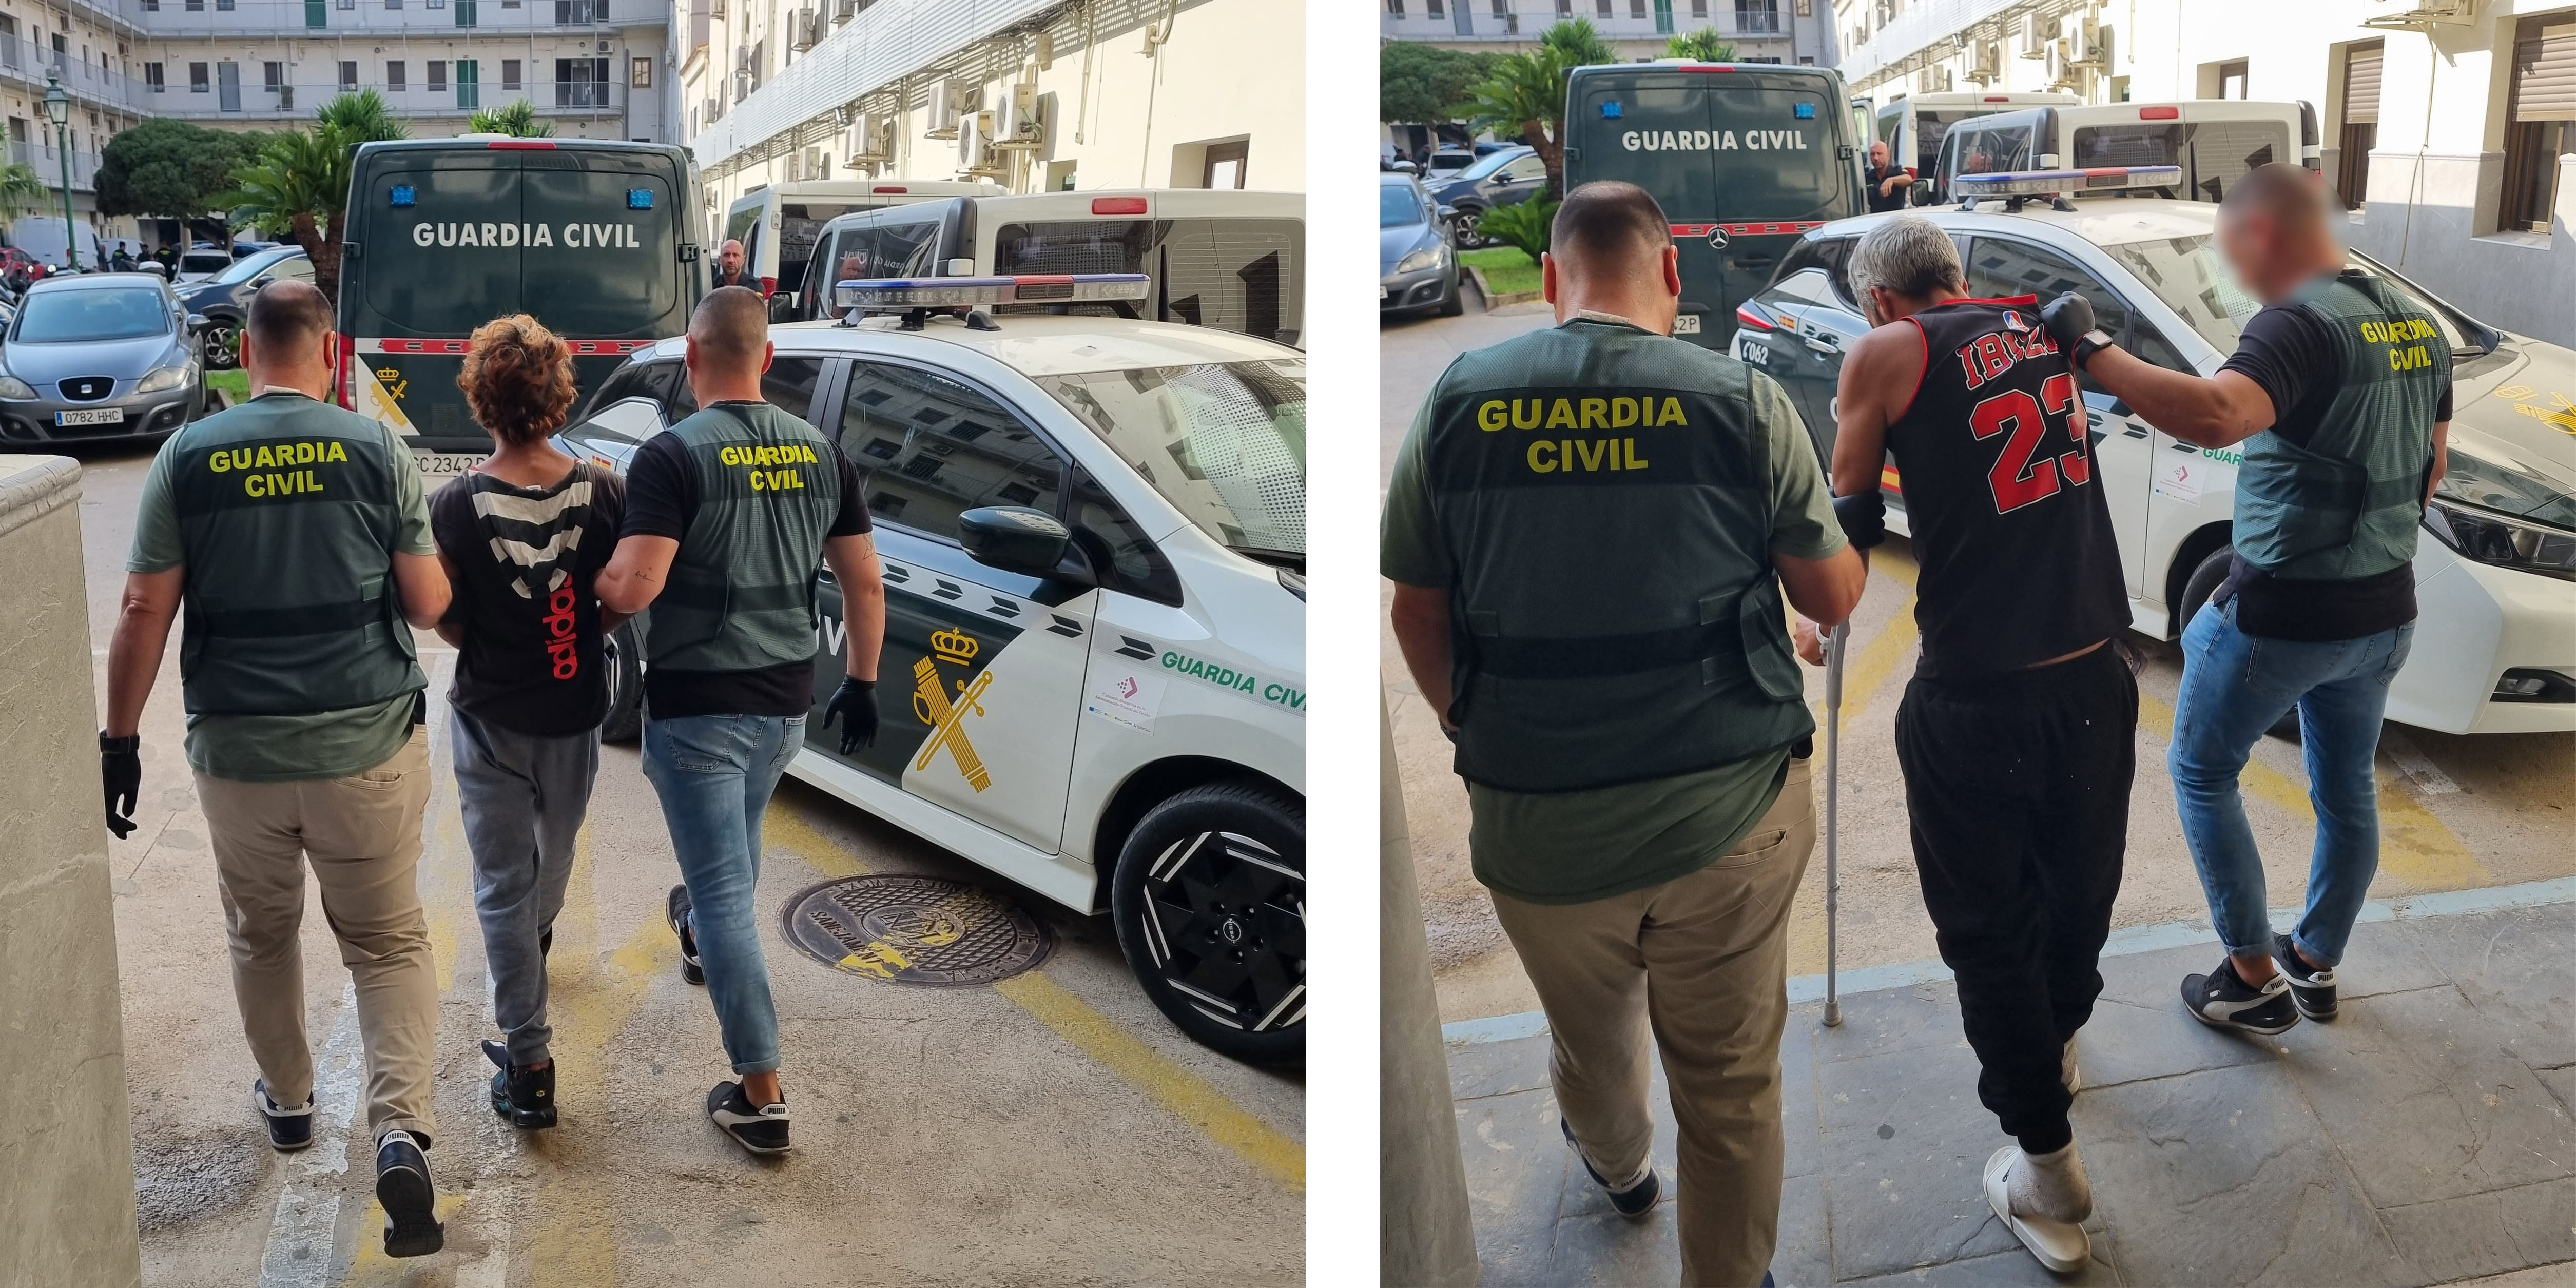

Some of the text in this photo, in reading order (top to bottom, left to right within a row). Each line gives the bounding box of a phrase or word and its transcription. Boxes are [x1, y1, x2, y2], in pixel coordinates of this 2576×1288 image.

[1622, 130, 1807, 151] GUARDIA CIVIL
[413, 222, 640, 248] GUARDIA CIVIL
[2361, 319, 2437, 343] GUARDIA
[1749, 342, 1769, 365] 062
[2390, 345, 2432, 370] CVIL
[65, 411, 119, 423] 0782 HHC
[1478, 397, 1688, 432] GUARDIA
[721, 445, 818, 466] GUARDIA
[1527, 438, 1649, 473] CIVIL
[1969, 372, 2090, 514] 23
[209, 442, 348, 473] GUARDIA
[2203, 448, 2242, 466] GUAR
[245, 470, 324, 497] CIVIL
[750, 469, 804, 491] CVIL
[1162, 651, 1306, 712] GUARDIA CIV
